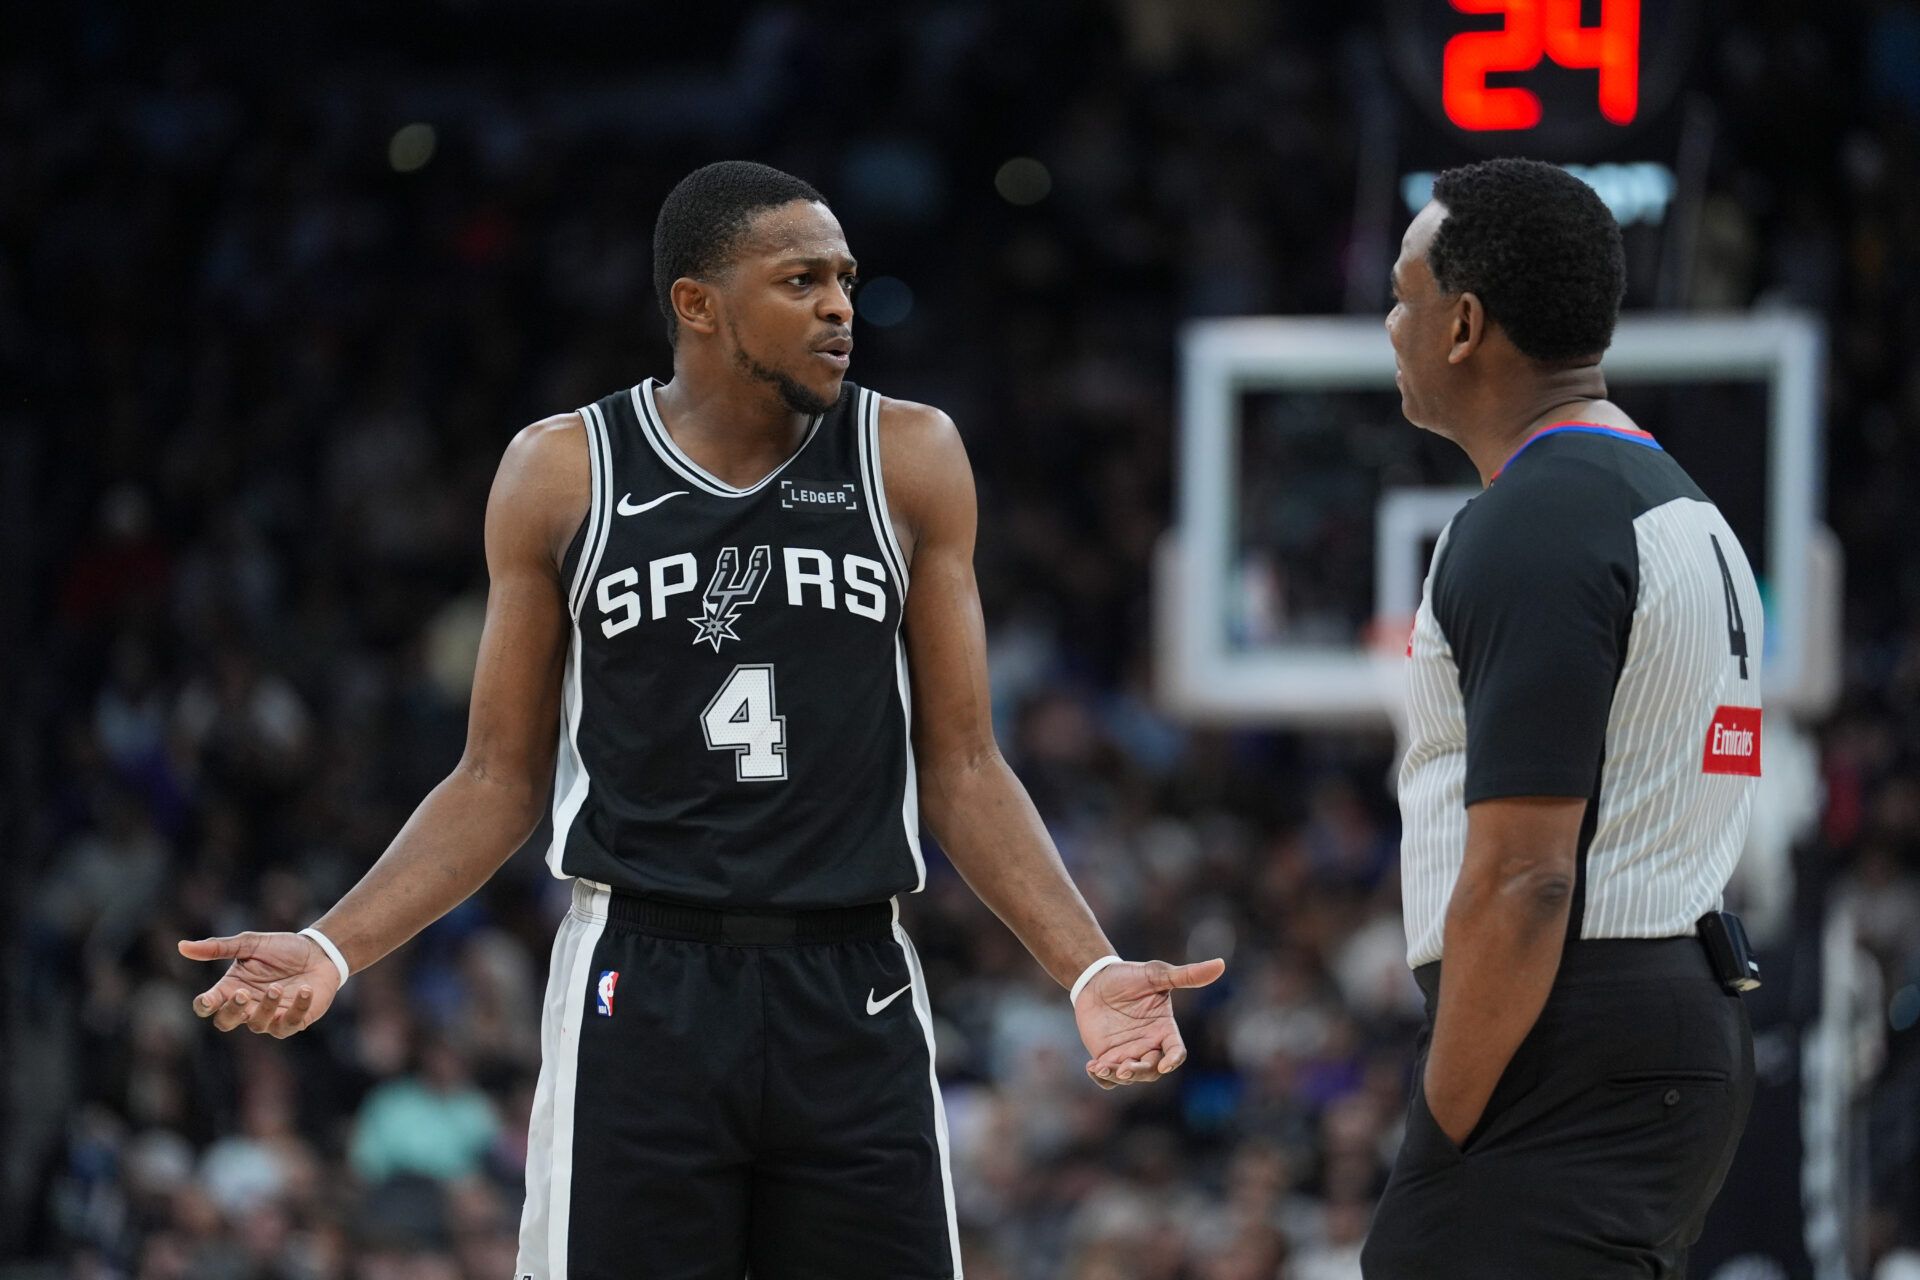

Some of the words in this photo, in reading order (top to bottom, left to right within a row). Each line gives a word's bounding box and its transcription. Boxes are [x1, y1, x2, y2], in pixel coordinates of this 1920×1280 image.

[1442, 0, 1641, 132] 24
[791, 488, 846, 503] LEDGER
[596, 545, 887, 654] SPURS
[1710, 533, 1748, 680] 4
[701, 663, 788, 782] 4
